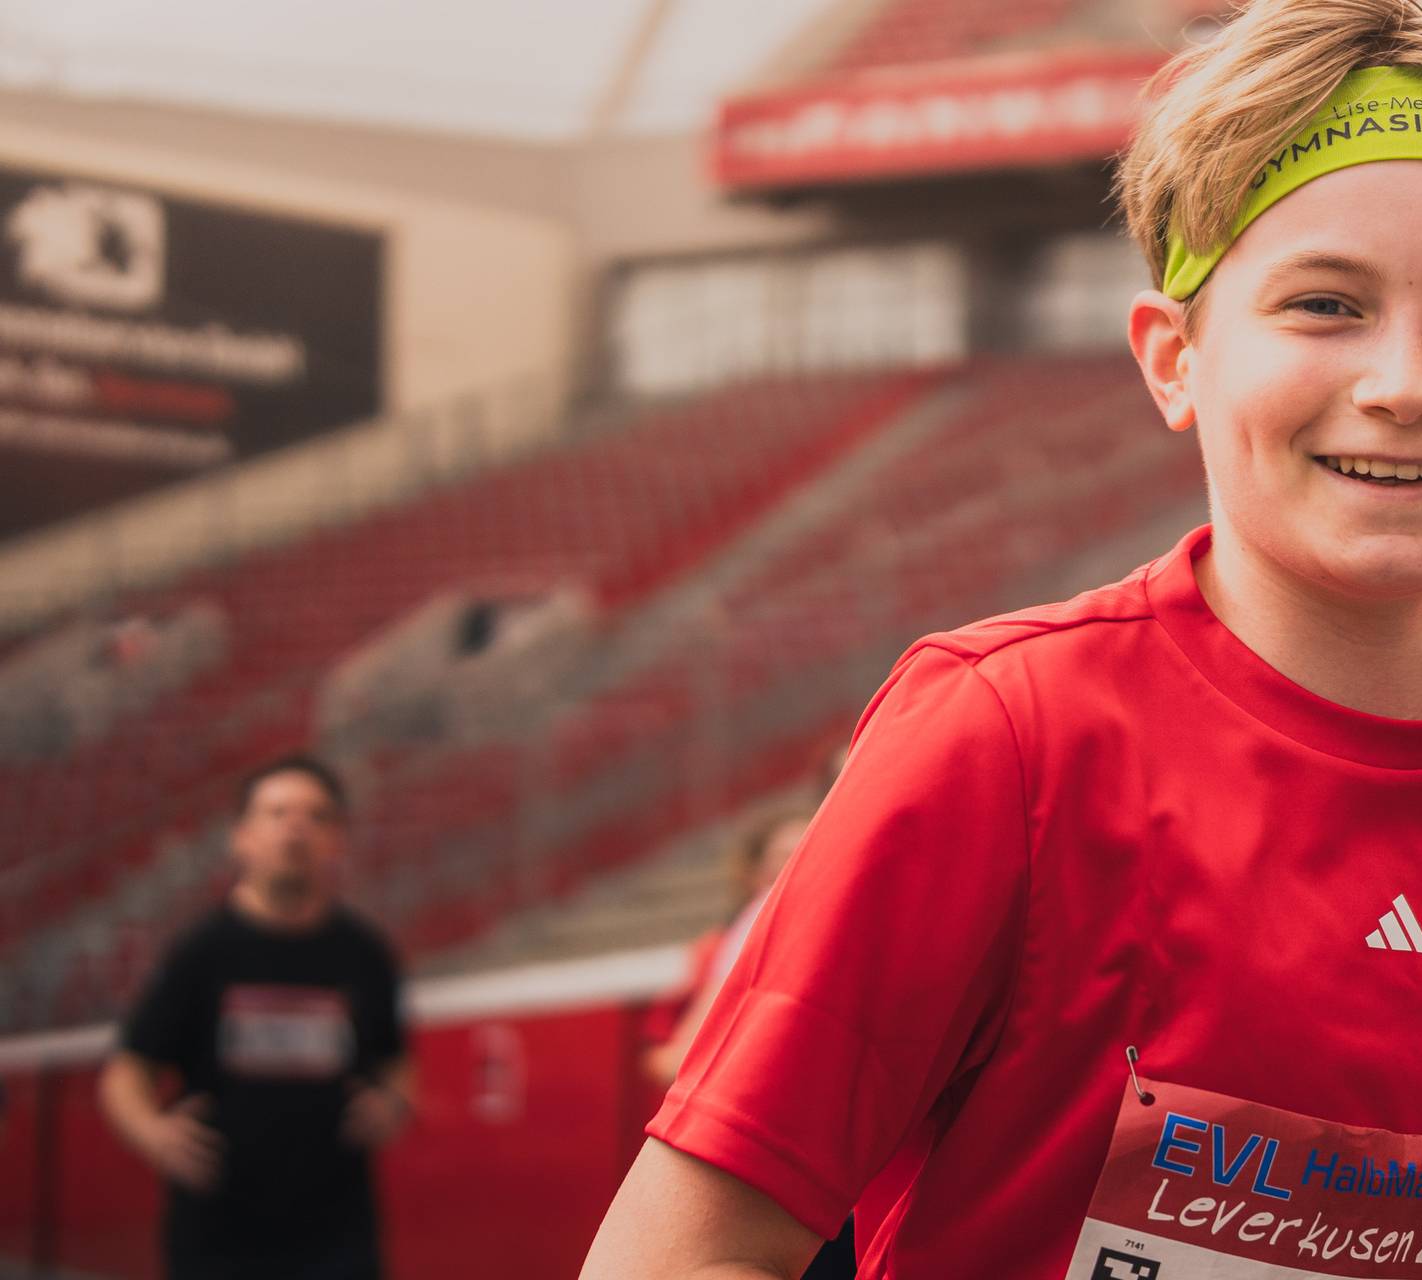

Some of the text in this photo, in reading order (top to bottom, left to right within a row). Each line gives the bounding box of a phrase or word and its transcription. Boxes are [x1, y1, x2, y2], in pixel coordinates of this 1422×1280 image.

[1151, 1111, 1292, 1200] EVL
[1124, 1239, 1145, 1251] 7141
[1147, 1178, 1414, 1264] Leverkusen
